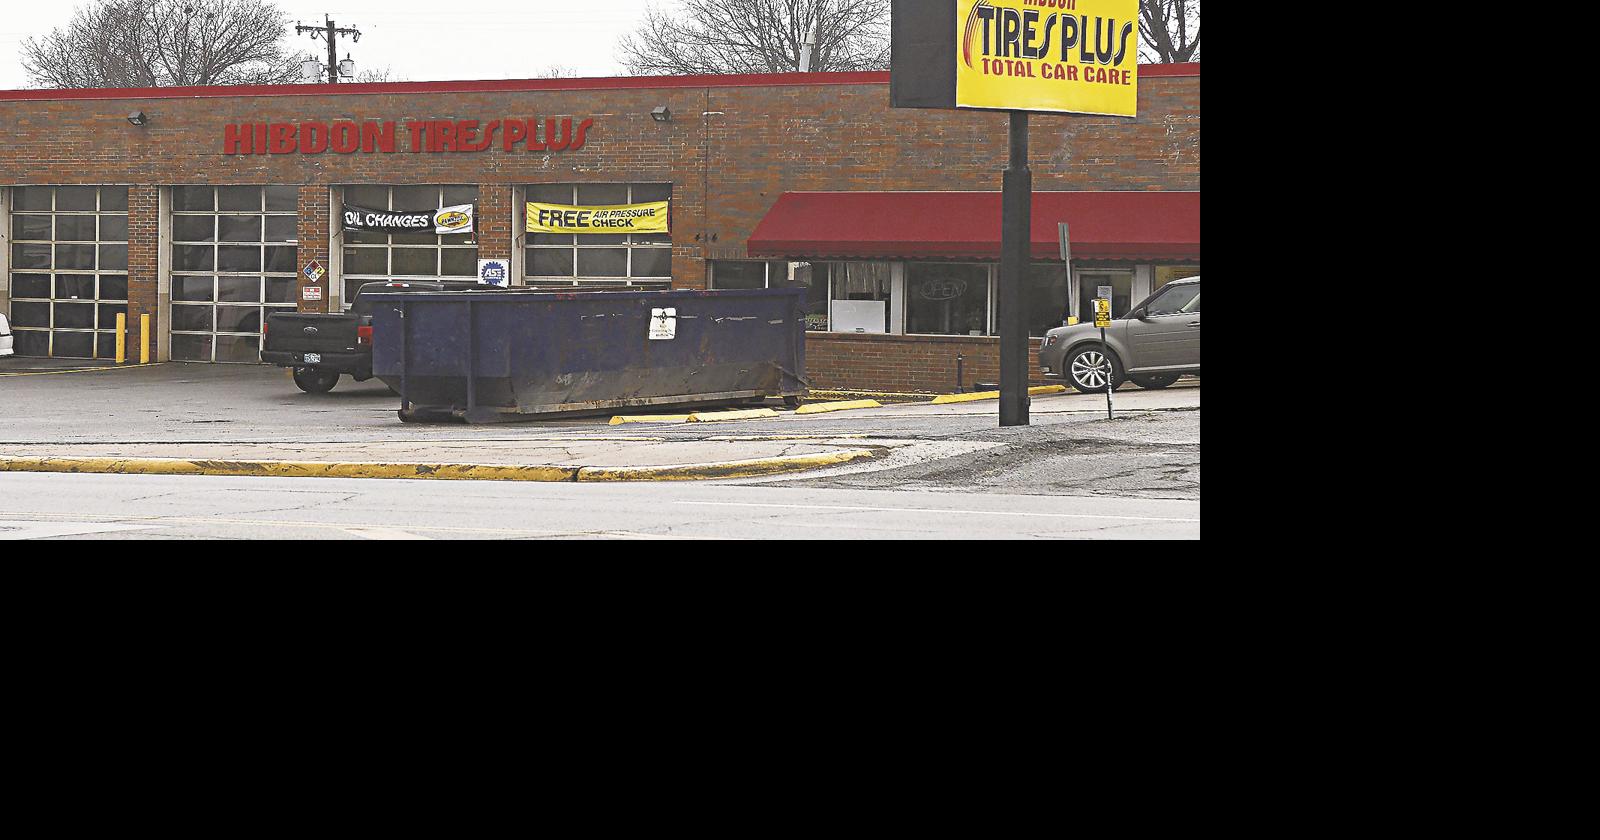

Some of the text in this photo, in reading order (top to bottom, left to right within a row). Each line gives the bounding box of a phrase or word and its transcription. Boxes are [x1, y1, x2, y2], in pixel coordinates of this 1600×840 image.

[982, 58, 1131, 86] TOTAL CAR CARE
[224, 120, 397, 155] HIBDON
[344, 211, 429, 228] OIL CHANGES
[538, 209, 593, 228] FREE
[592, 208, 656, 219] AIR PRESSURE
[592, 218, 634, 228] CHECK
[484, 268, 502, 277] ASE
